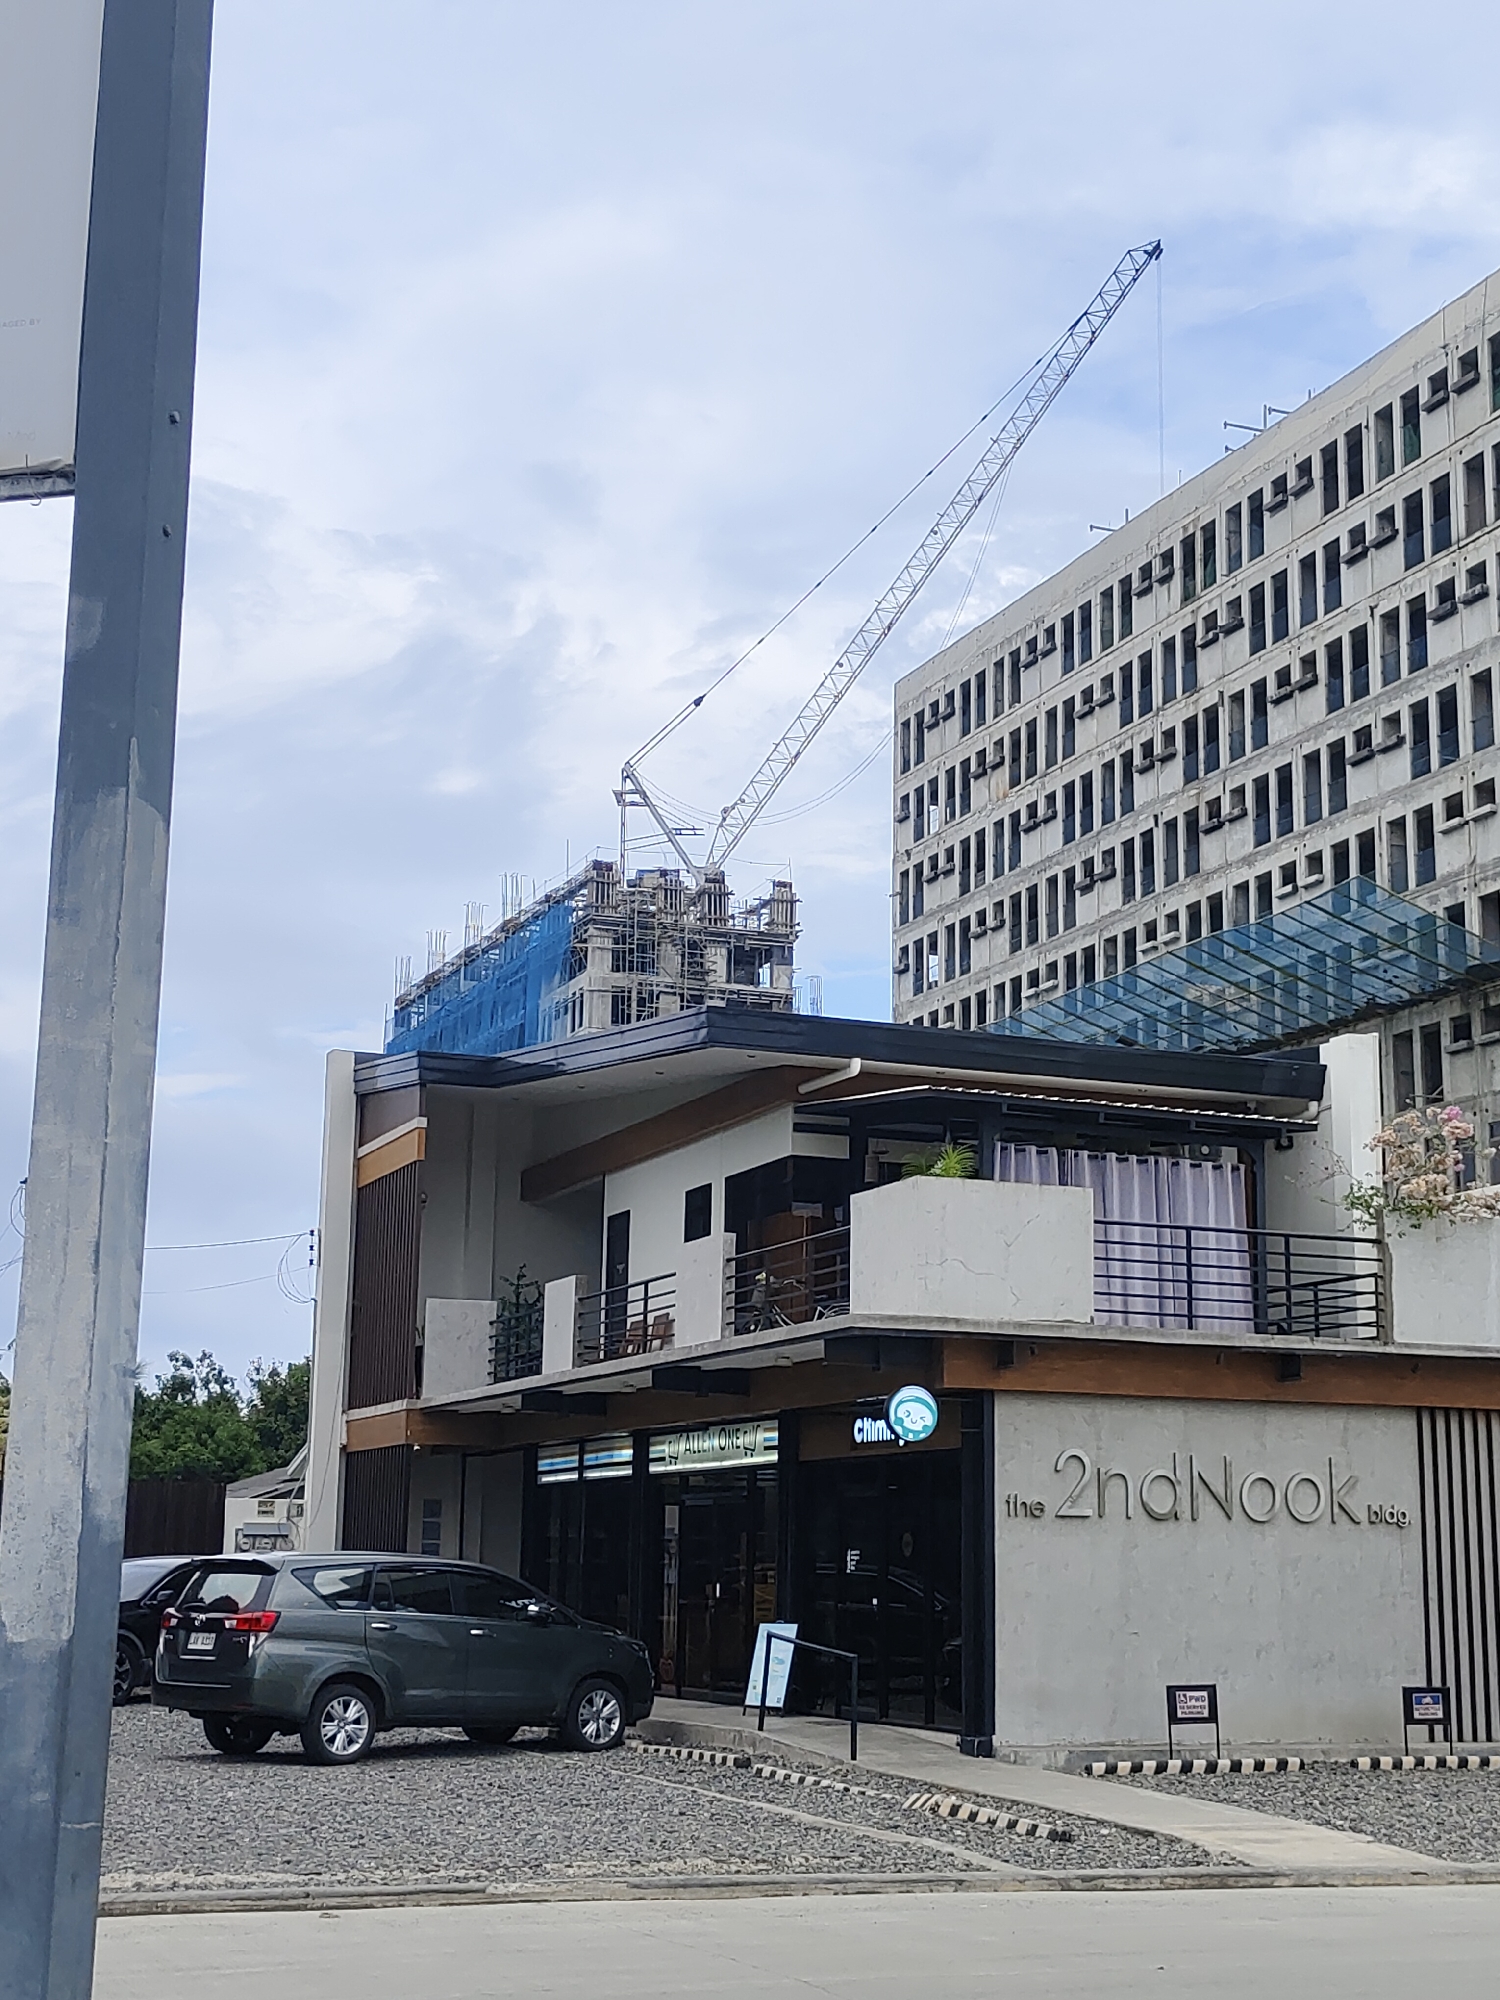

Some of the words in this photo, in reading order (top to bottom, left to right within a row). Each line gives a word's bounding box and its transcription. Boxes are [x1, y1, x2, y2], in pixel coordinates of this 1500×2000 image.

[684, 1430, 715, 1454] ALLEN
[718, 1427, 741, 1450] ONE
[1006, 1492, 1046, 1519] the
